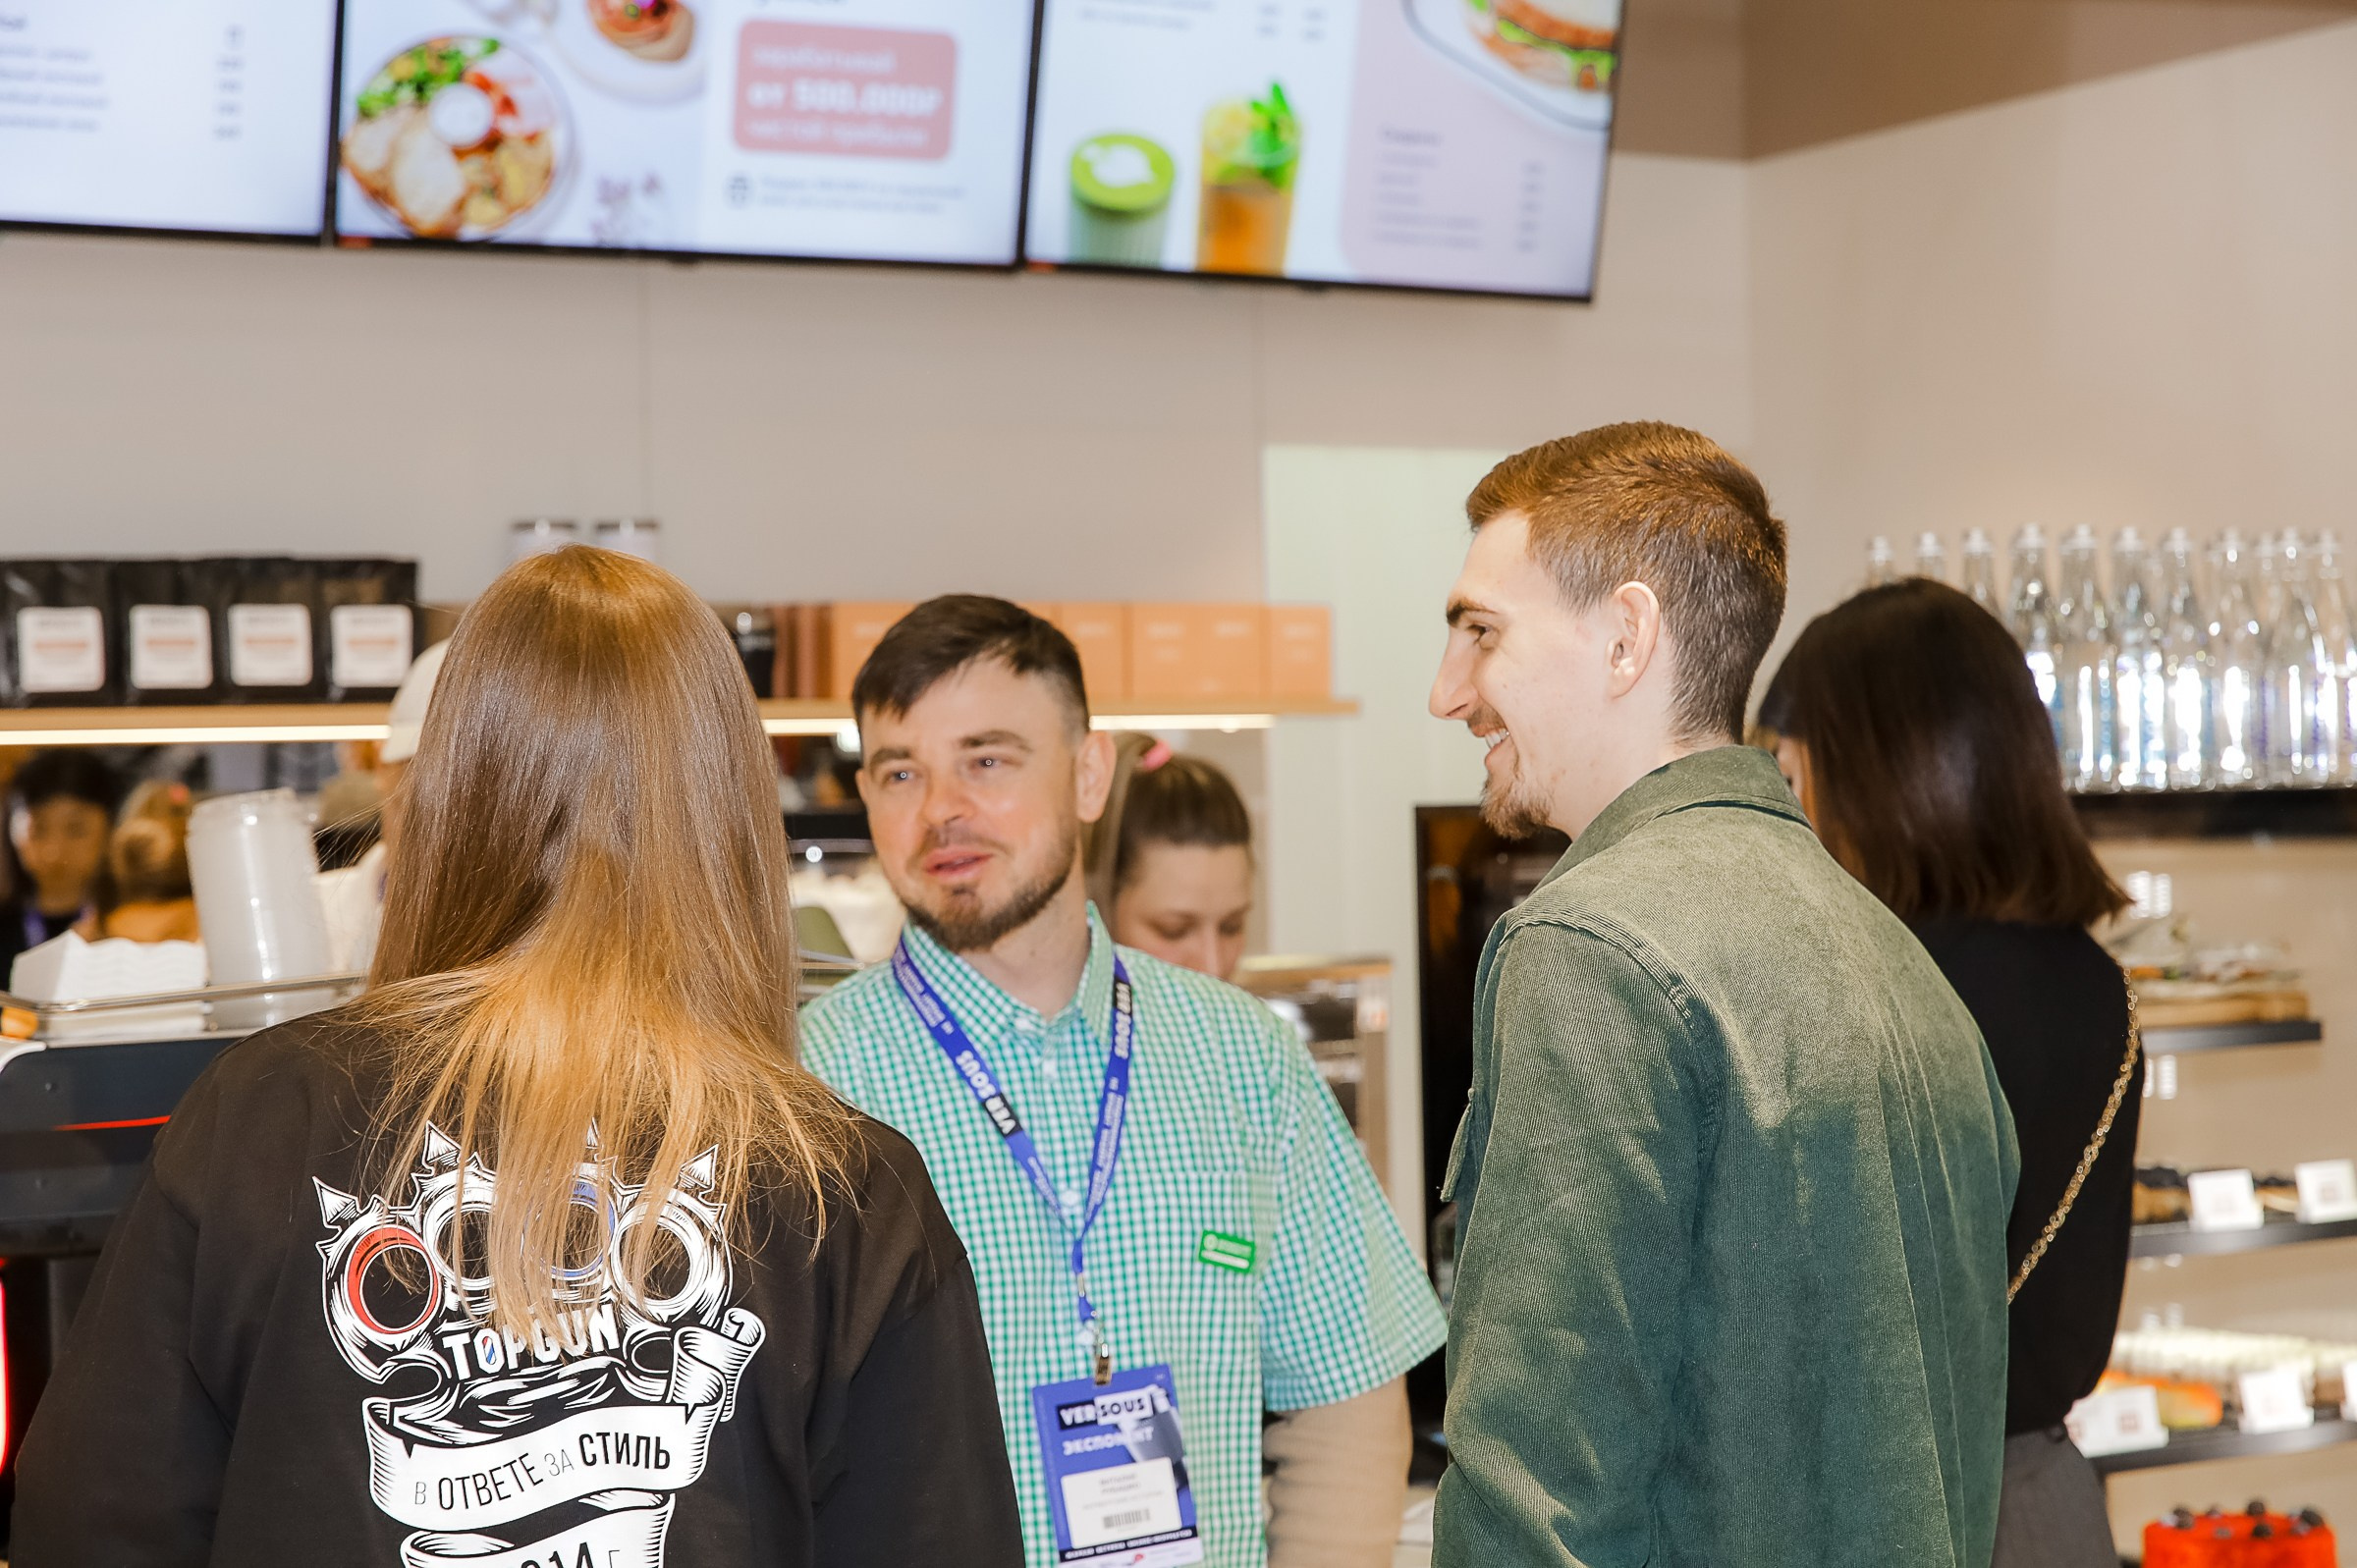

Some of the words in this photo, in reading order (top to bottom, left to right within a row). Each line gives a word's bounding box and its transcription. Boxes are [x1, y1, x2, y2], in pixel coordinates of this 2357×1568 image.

[414, 1482, 426, 1505] В
[438, 1452, 543, 1510] ОТВЕТЕ
[544, 1449, 575, 1476] ЗА
[578, 1432, 671, 1470] СТИЛЬ
